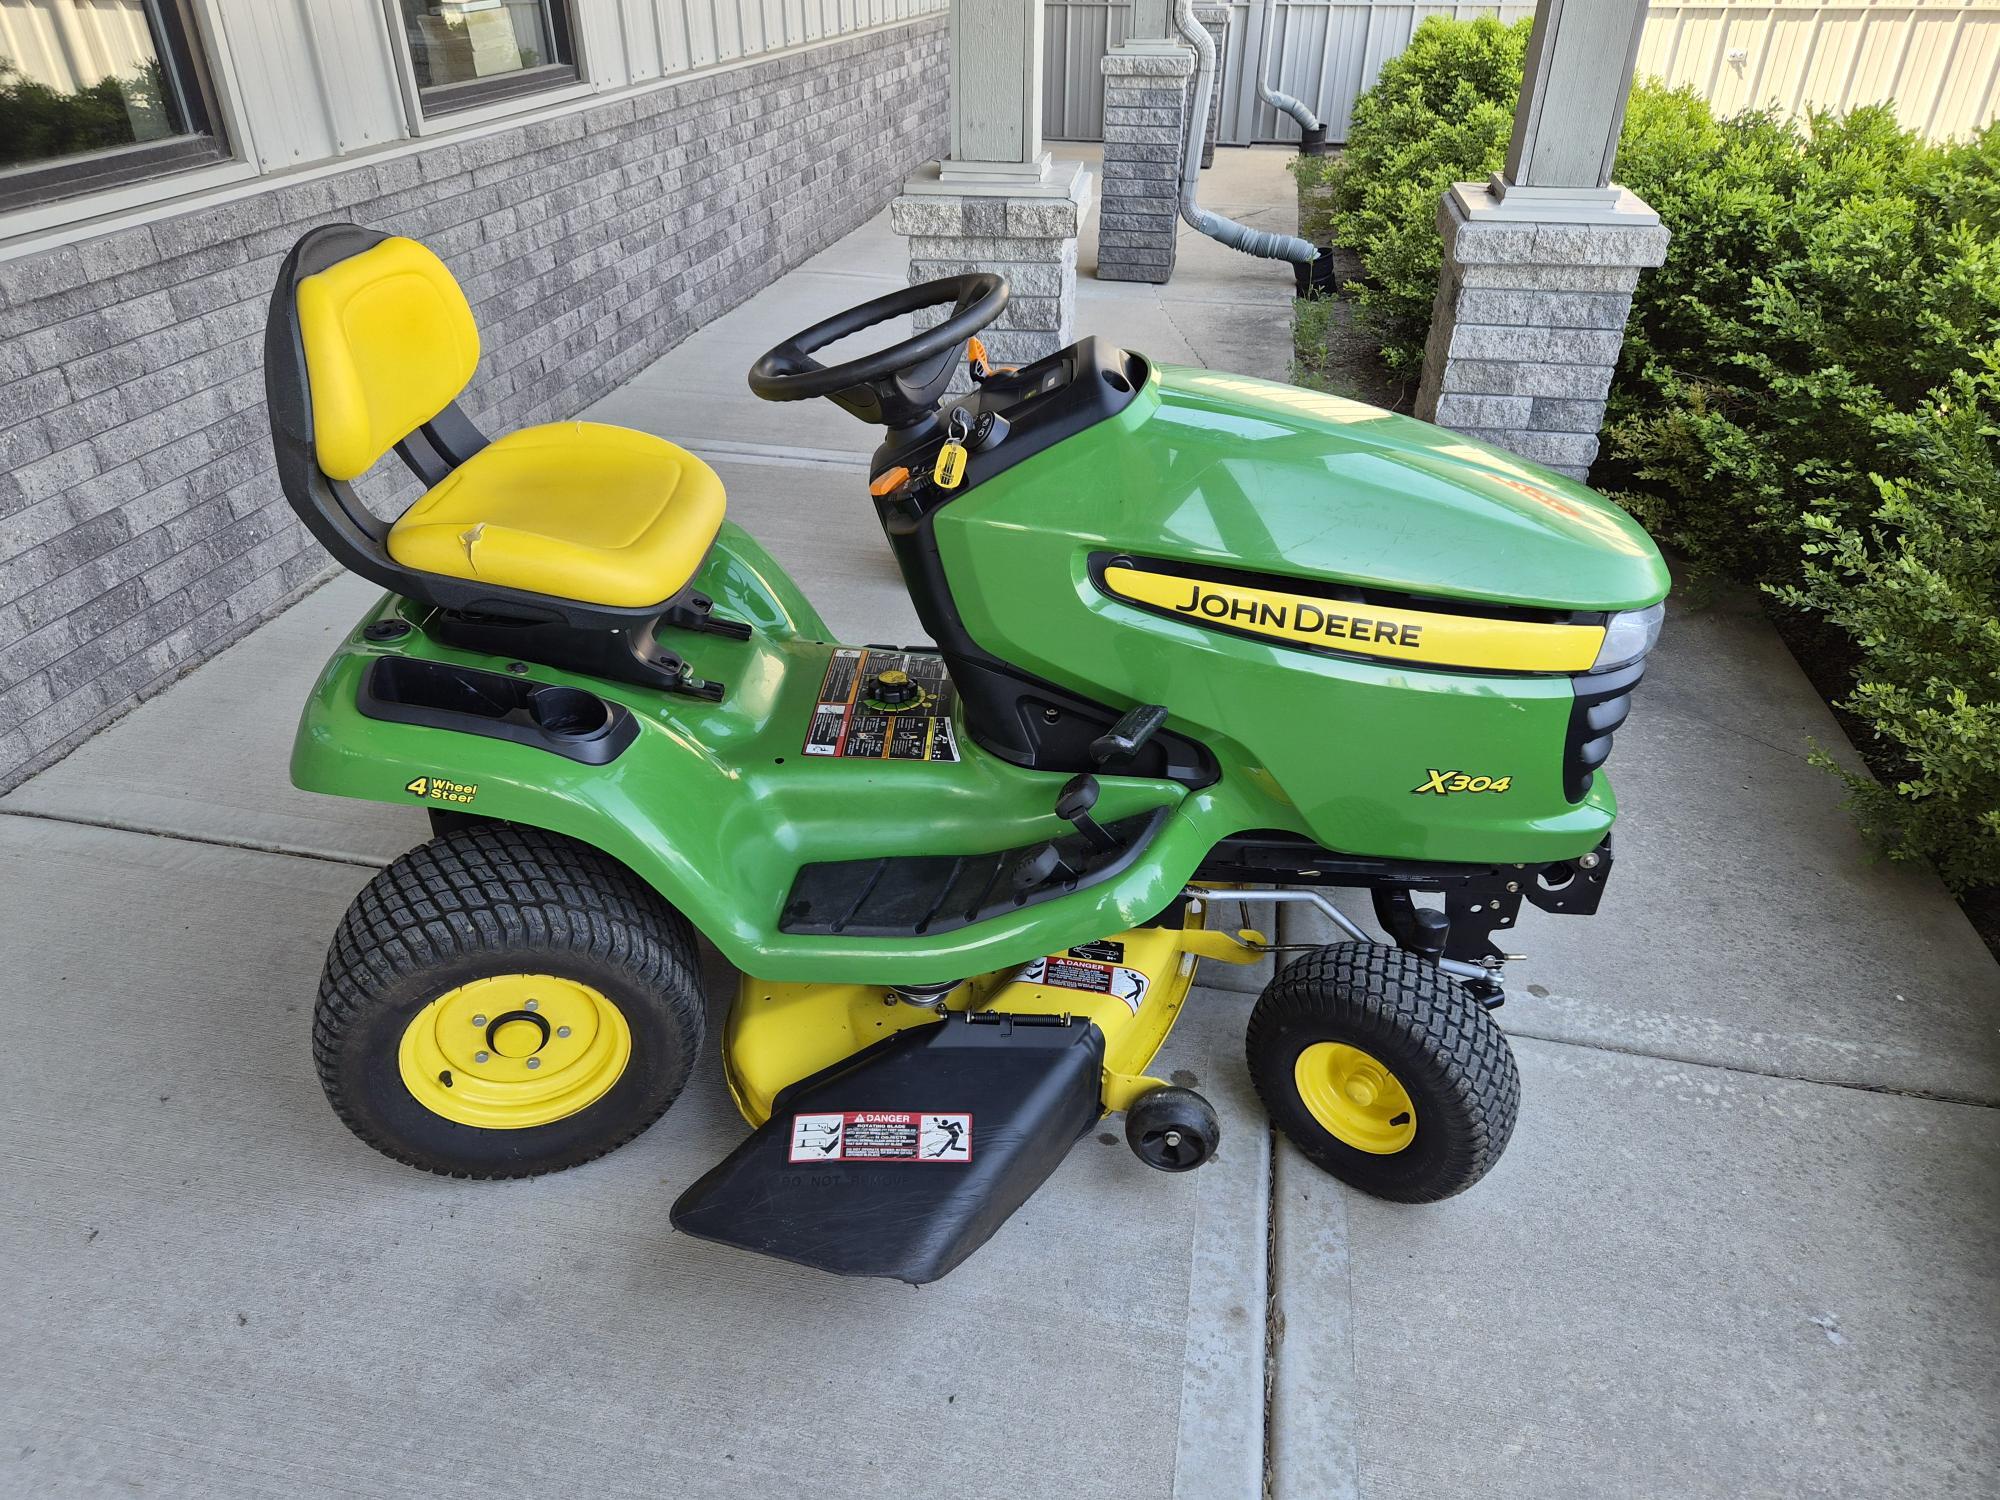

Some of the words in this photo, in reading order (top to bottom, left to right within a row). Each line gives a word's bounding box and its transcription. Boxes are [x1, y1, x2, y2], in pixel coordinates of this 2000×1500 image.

[1176, 586, 1287, 628] JOHN
[1293, 604, 1423, 648] DEERE
[407, 776, 428, 796] 4
[432, 779, 477, 794] Wheel
[1413, 769, 1511, 795] X304
[431, 789, 474, 803] Steer
[1066, 960, 1104, 970] DANGER
[866, 1114, 910, 1123] DANGER
[810, 1175, 841, 1186] NOT
